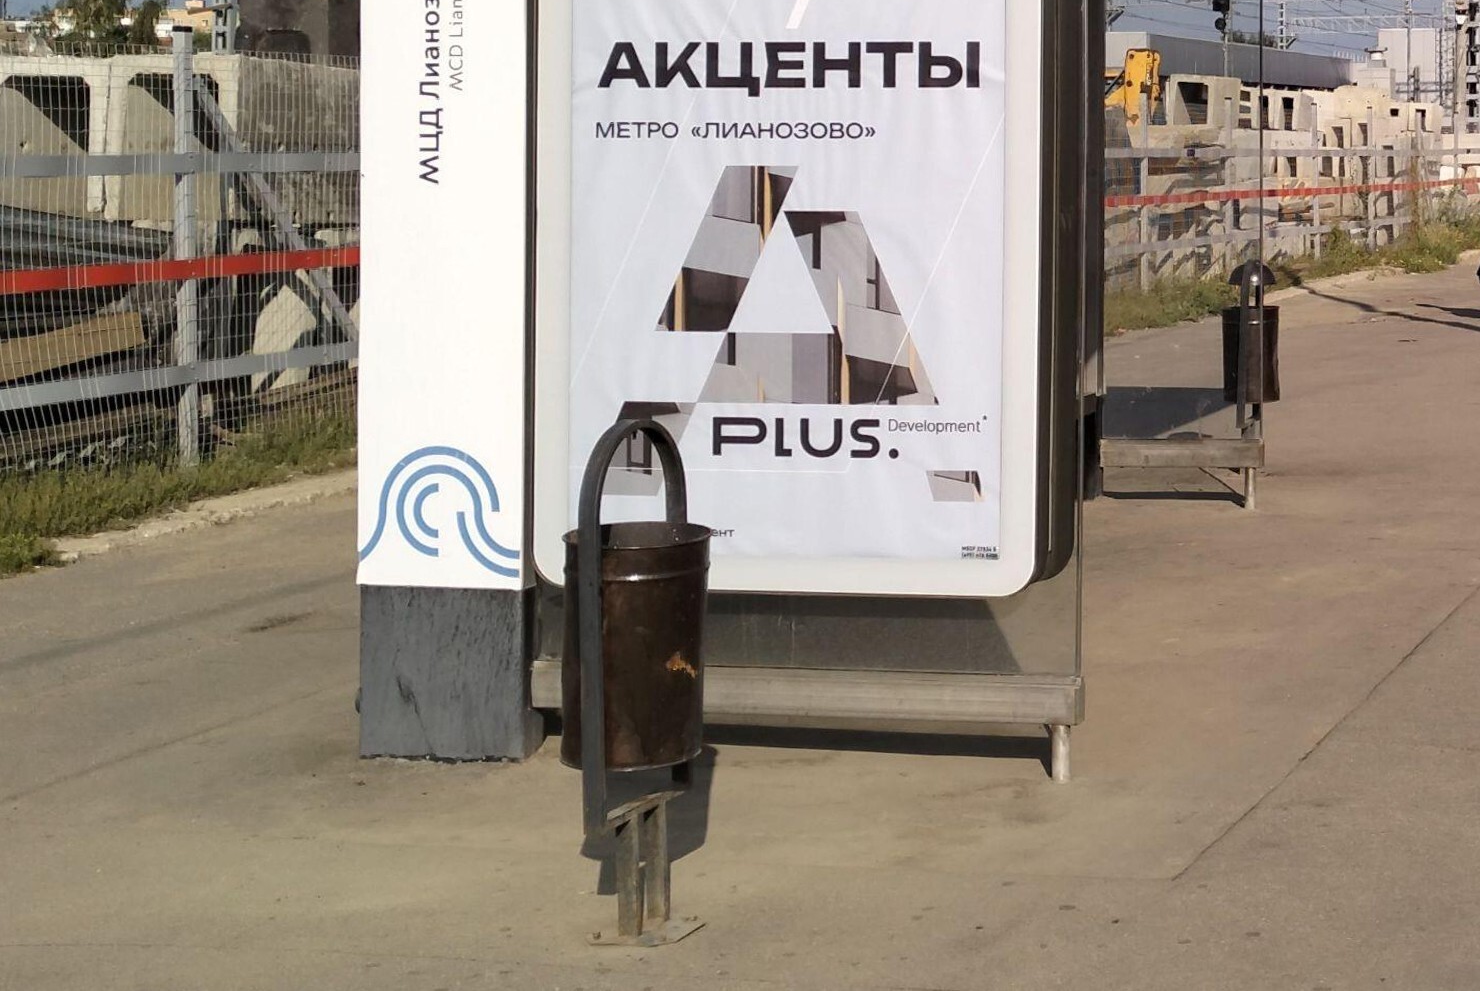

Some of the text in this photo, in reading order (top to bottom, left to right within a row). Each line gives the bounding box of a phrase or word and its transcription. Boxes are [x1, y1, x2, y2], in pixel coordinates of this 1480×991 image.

[448, 44, 464, 92] MCD
[597, 41, 981, 98] АКЦЕНТЫ
[418, 107, 444, 185] МЦД
[595, 121, 876, 140] МЕТРО «ЛИАНОЗОВО»
[887, 418, 981, 434] Development
